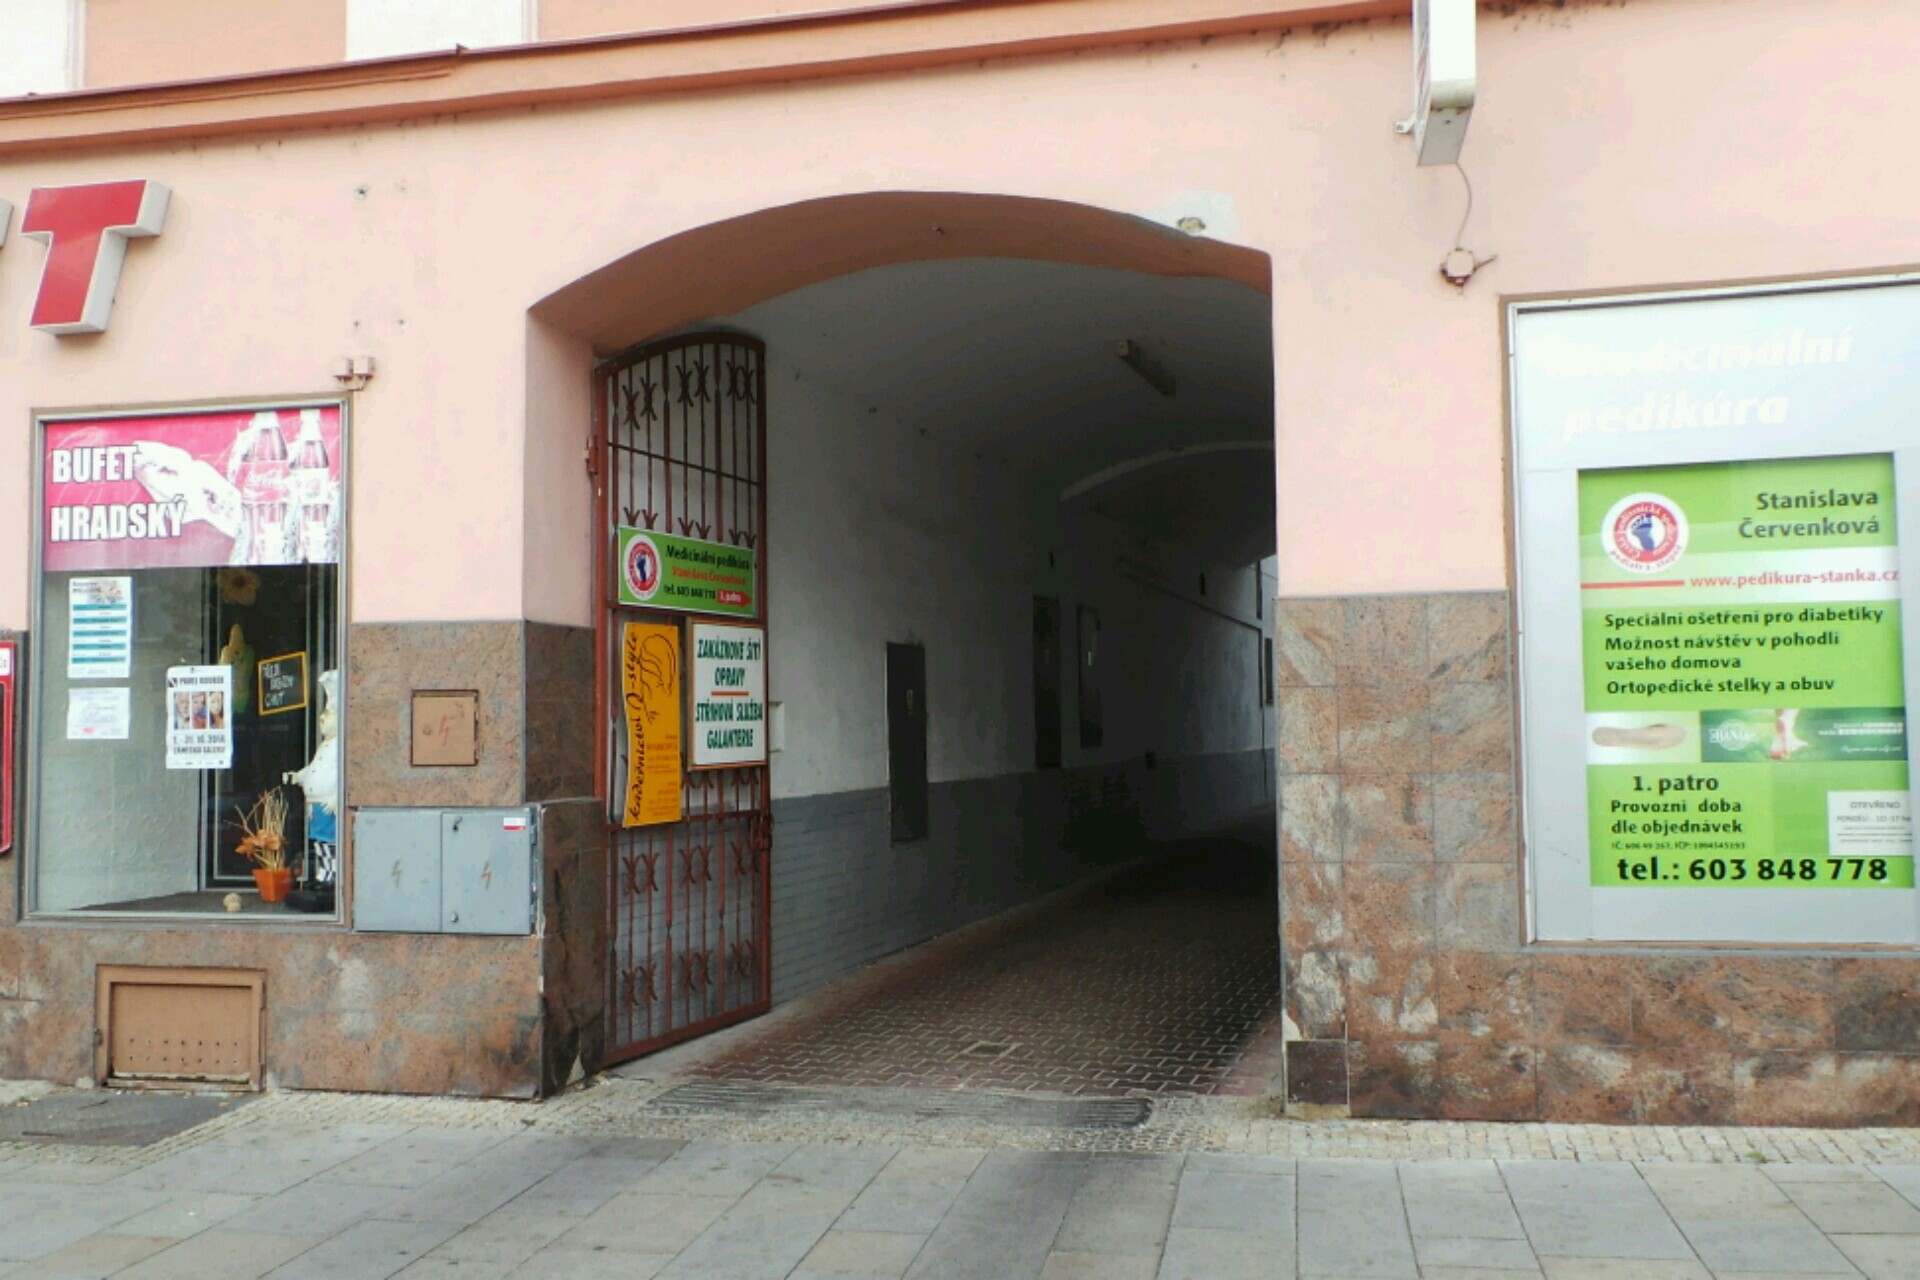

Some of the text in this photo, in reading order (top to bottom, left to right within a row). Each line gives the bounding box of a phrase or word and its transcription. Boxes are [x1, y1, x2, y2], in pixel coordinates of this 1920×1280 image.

[1562, 392, 1790, 442] pedikúra
[51, 445, 139, 483] BUFET
[1756, 489, 1879, 511] Stanislava
[50, 493, 187, 542] HRADSKÝ
[1738, 515, 1880, 538] Červenková
[1690, 567, 1901, 588] www.pedikura-stanka.cz
[1605, 607, 1883, 630] Speciální ošetření pro diabetiky
[1605, 631, 1839, 651] Možnost návštěv v pohodlí
[1606, 656, 1741, 671] vašeho domova
[715, 667, 745, 687] OPRAVY
[1607, 676, 1836, 696] Ortopedické stelky a obuv
[736, 699, 763, 721] SLUŽBA
[707, 729, 753, 749] GALANTERIE
[1632, 775, 1719, 795] 1. patro
[1611, 798, 1741, 813] Provozní doba
[1850, 800, 1901, 809] OTEVŘENO
[1611, 820, 1743, 837] dle objednávek
[1617, 856, 1888, 881] tel.: 603 848 778
